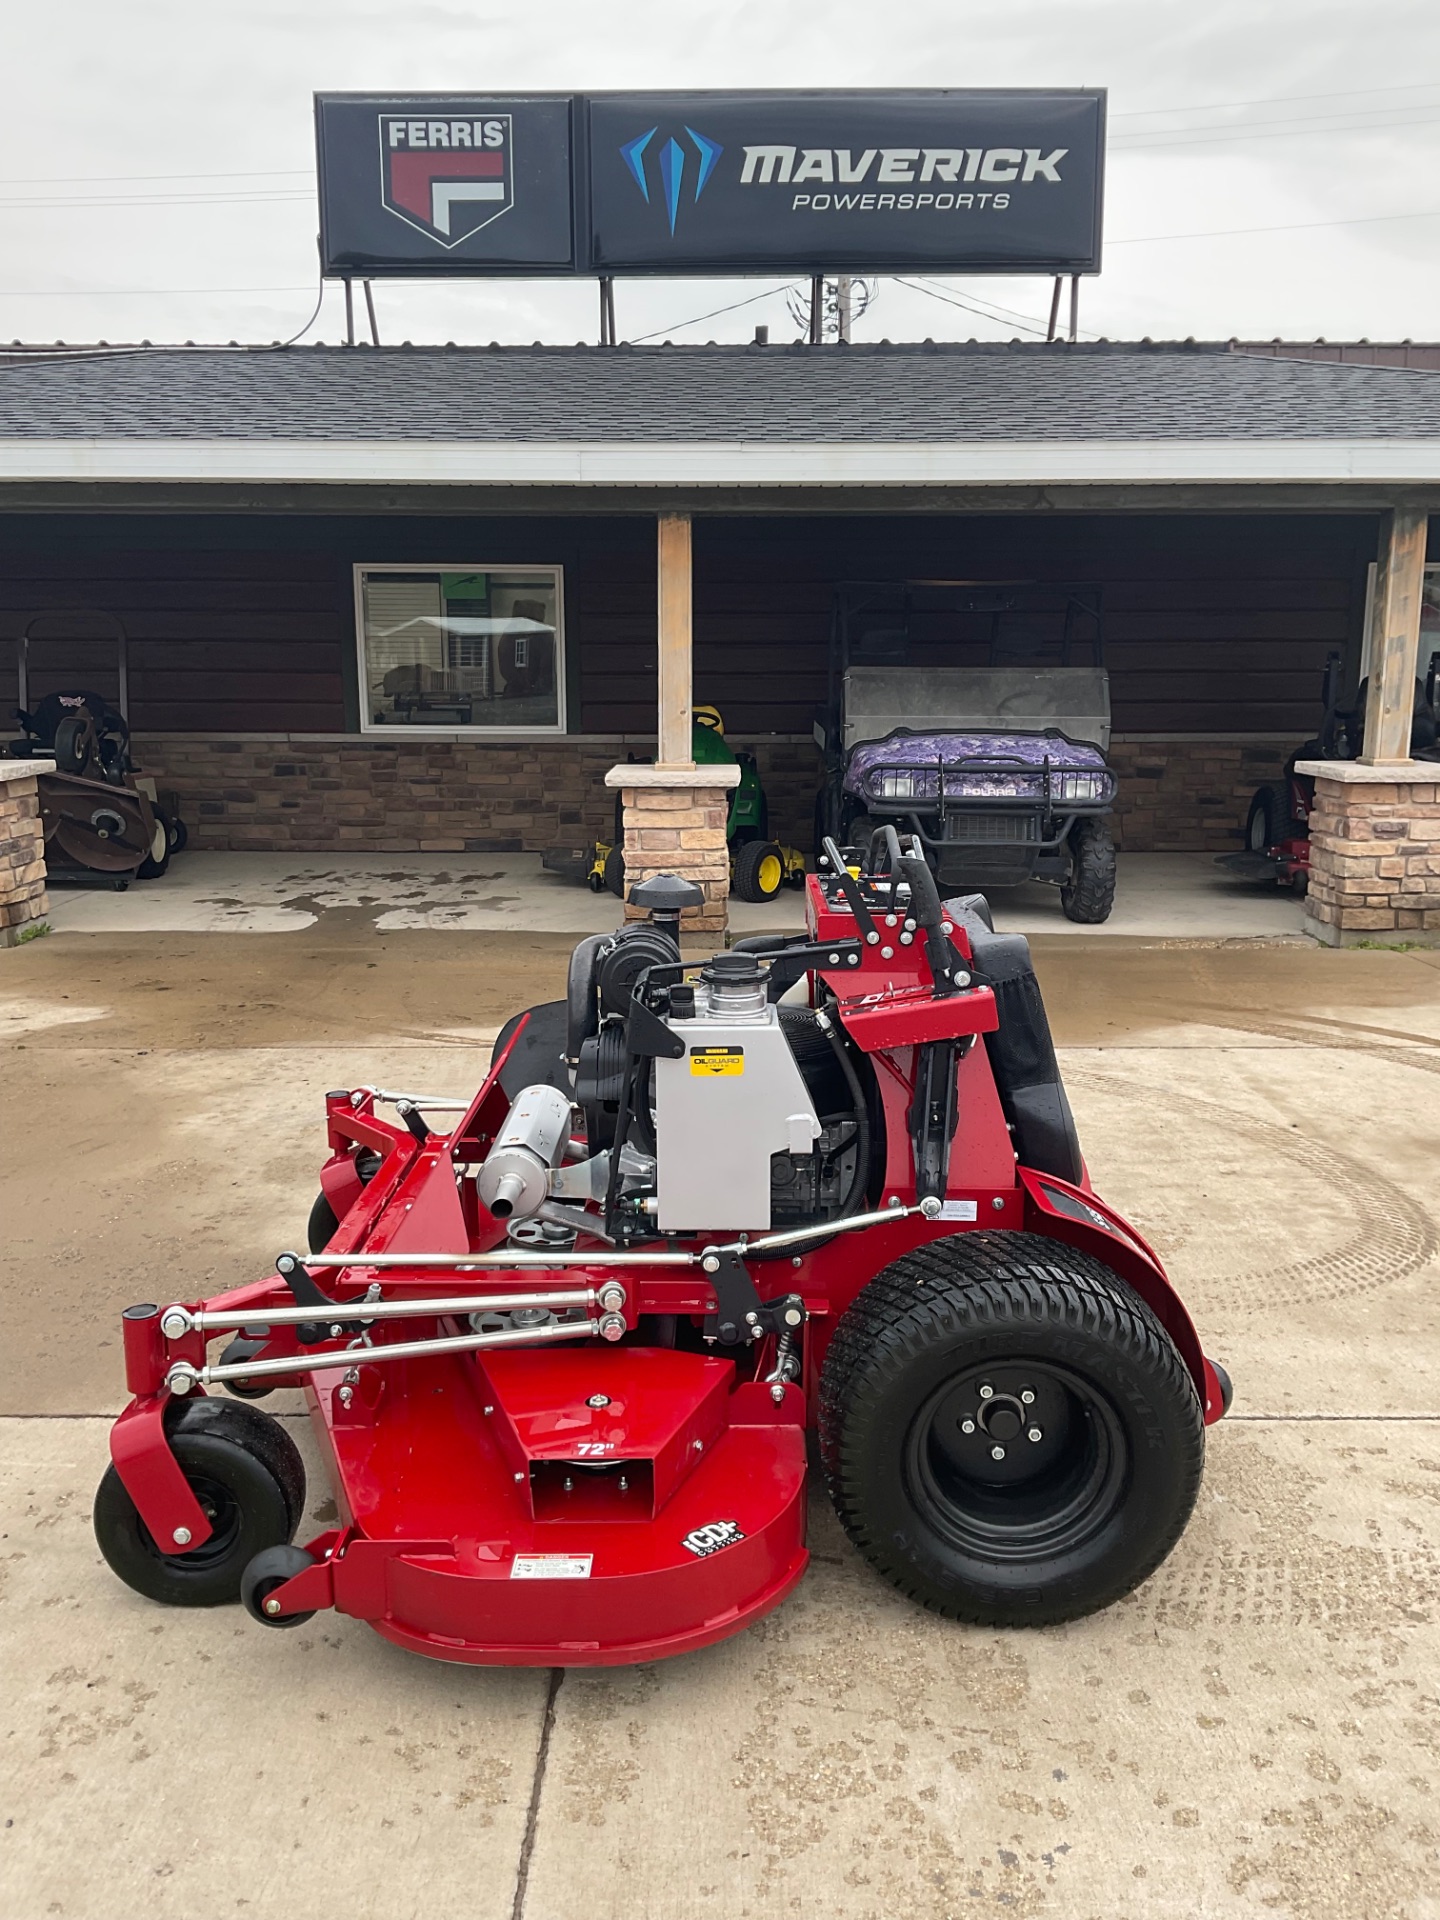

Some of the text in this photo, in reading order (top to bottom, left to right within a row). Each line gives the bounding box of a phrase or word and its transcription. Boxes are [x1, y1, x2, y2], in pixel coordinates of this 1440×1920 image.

[388, 121, 504, 147] FERRIS
[740, 145, 1069, 183] MAVERICK
[792, 193, 1011, 210] POWERSPORTS
[962, 787, 1017, 797] POLARIS
[577, 1442, 615, 1456] 72"
